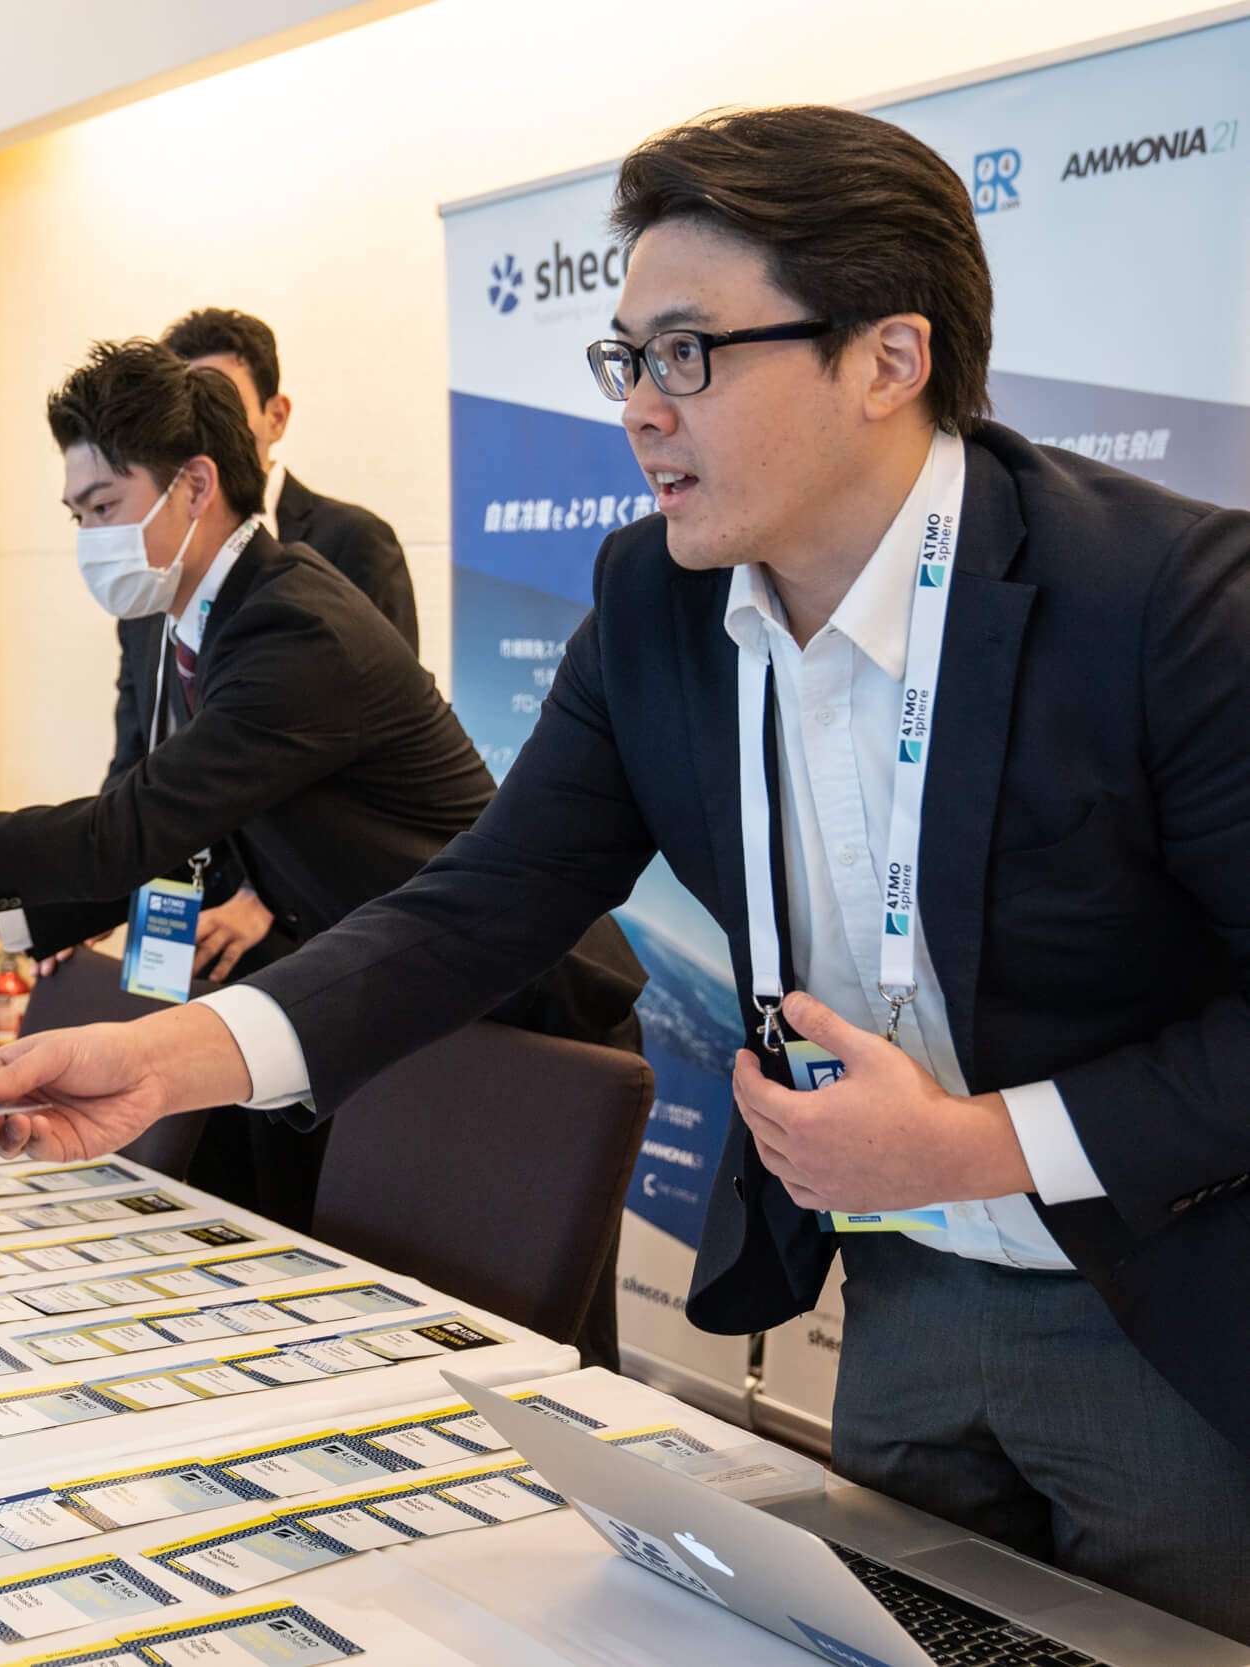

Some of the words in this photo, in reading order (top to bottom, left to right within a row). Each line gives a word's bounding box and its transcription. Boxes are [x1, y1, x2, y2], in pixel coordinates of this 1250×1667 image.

[923, 513, 940, 561] ATMO
[938, 515, 953, 561] sphere
[901, 688, 917, 736] ATMO
[915, 689, 929, 736] sphere
[886, 862, 901, 909] ATMO
[899, 864, 914, 910] sphere
[341, 1452, 368, 1468] ATMO
[197, 1478, 223, 1495] ATMO
[295, 1535, 325, 1550] ATMO
[111, 1581, 138, 1599] ATMO
[290, 1629, 318, 1648] ATMO
